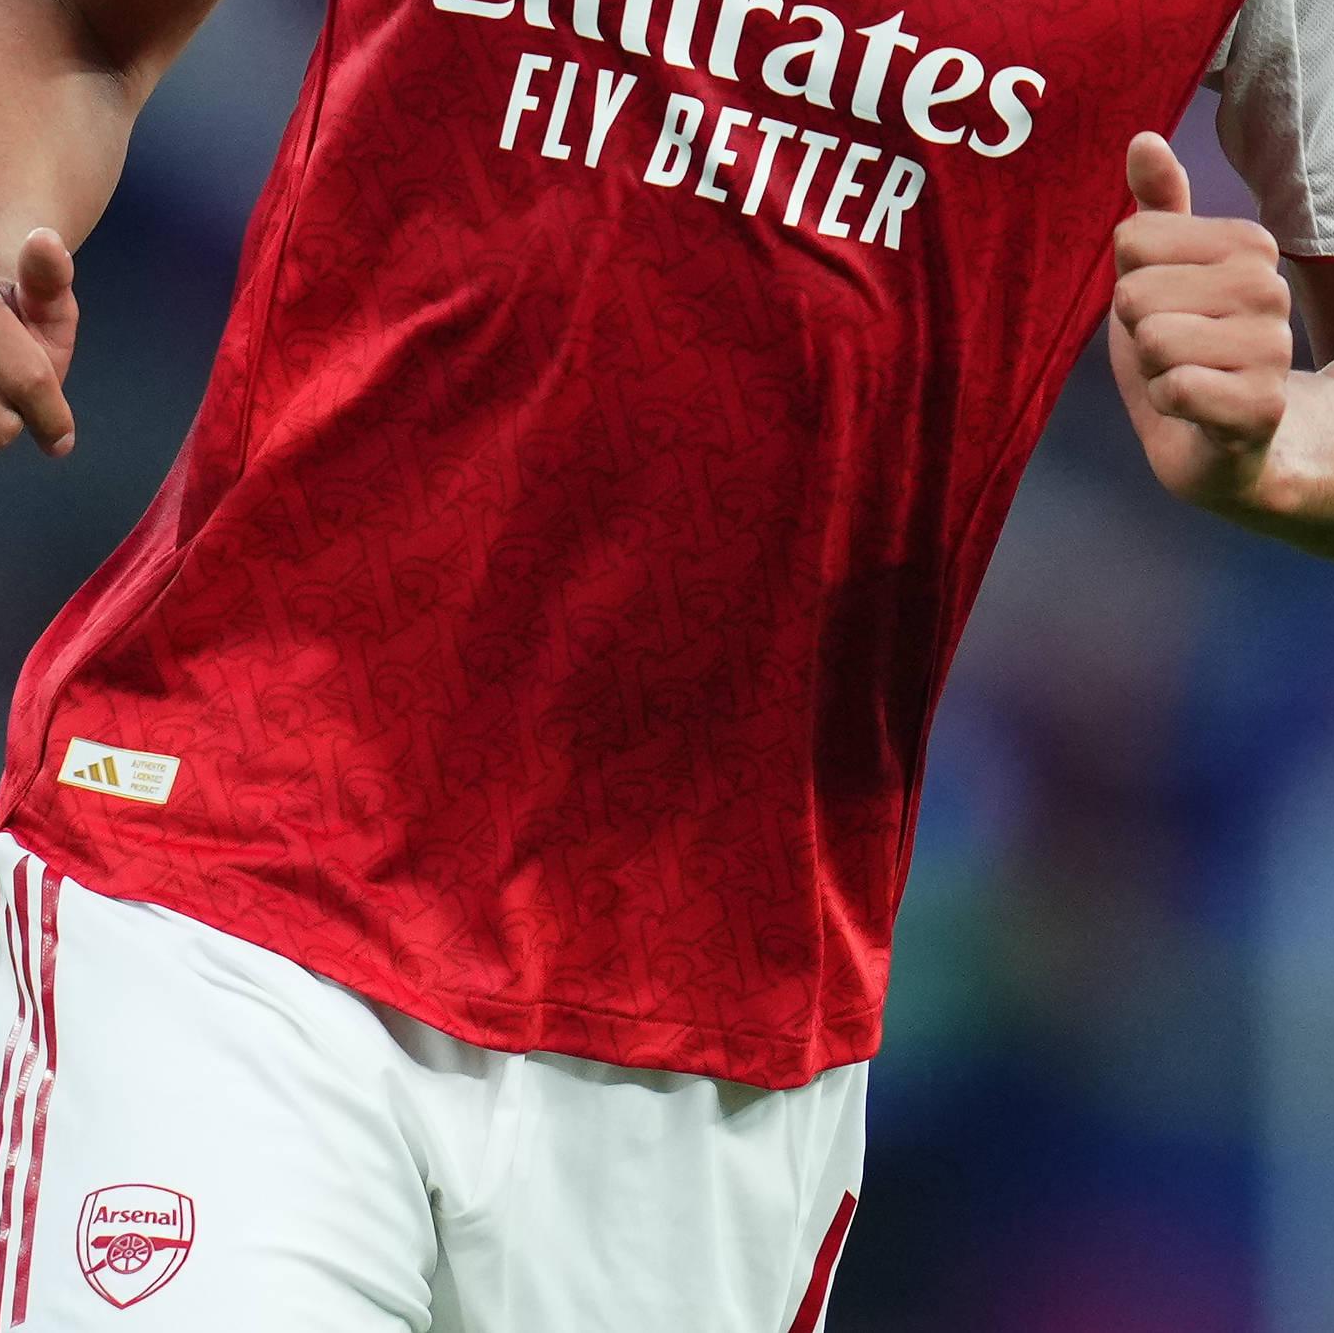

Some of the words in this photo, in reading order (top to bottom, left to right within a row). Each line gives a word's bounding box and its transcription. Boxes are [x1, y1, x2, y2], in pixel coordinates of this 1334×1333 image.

[499, 53, 638, 169] FLY
[643, 92, 926, 250] BETTER
[93, 1206, 177, 1226] Arsenal
